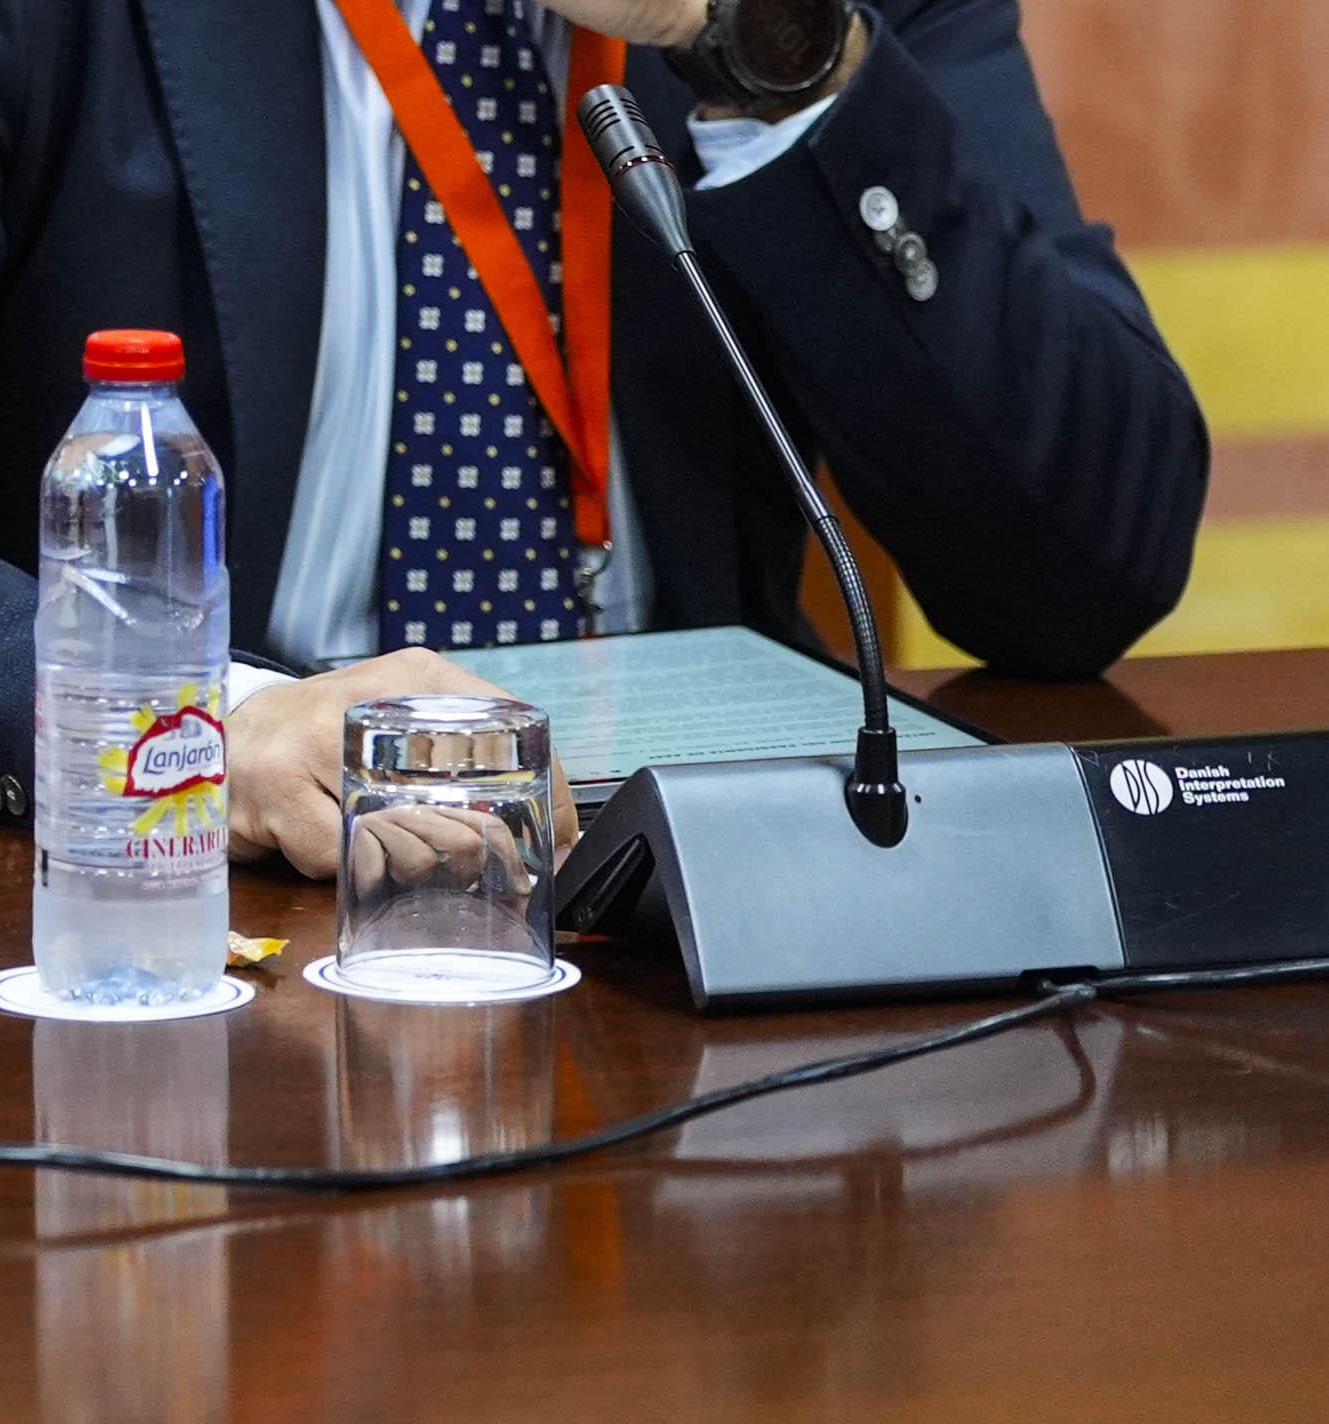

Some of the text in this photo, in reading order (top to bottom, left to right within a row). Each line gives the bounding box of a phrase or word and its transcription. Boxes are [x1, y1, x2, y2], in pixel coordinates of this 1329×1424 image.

[143, 740, 220, 775] Lanjarón
[1174, 766, 1230, 779] Danish
[1179, 776, 1285, 792] Interpretation
[1183, 791, 1249, 806] Systems
